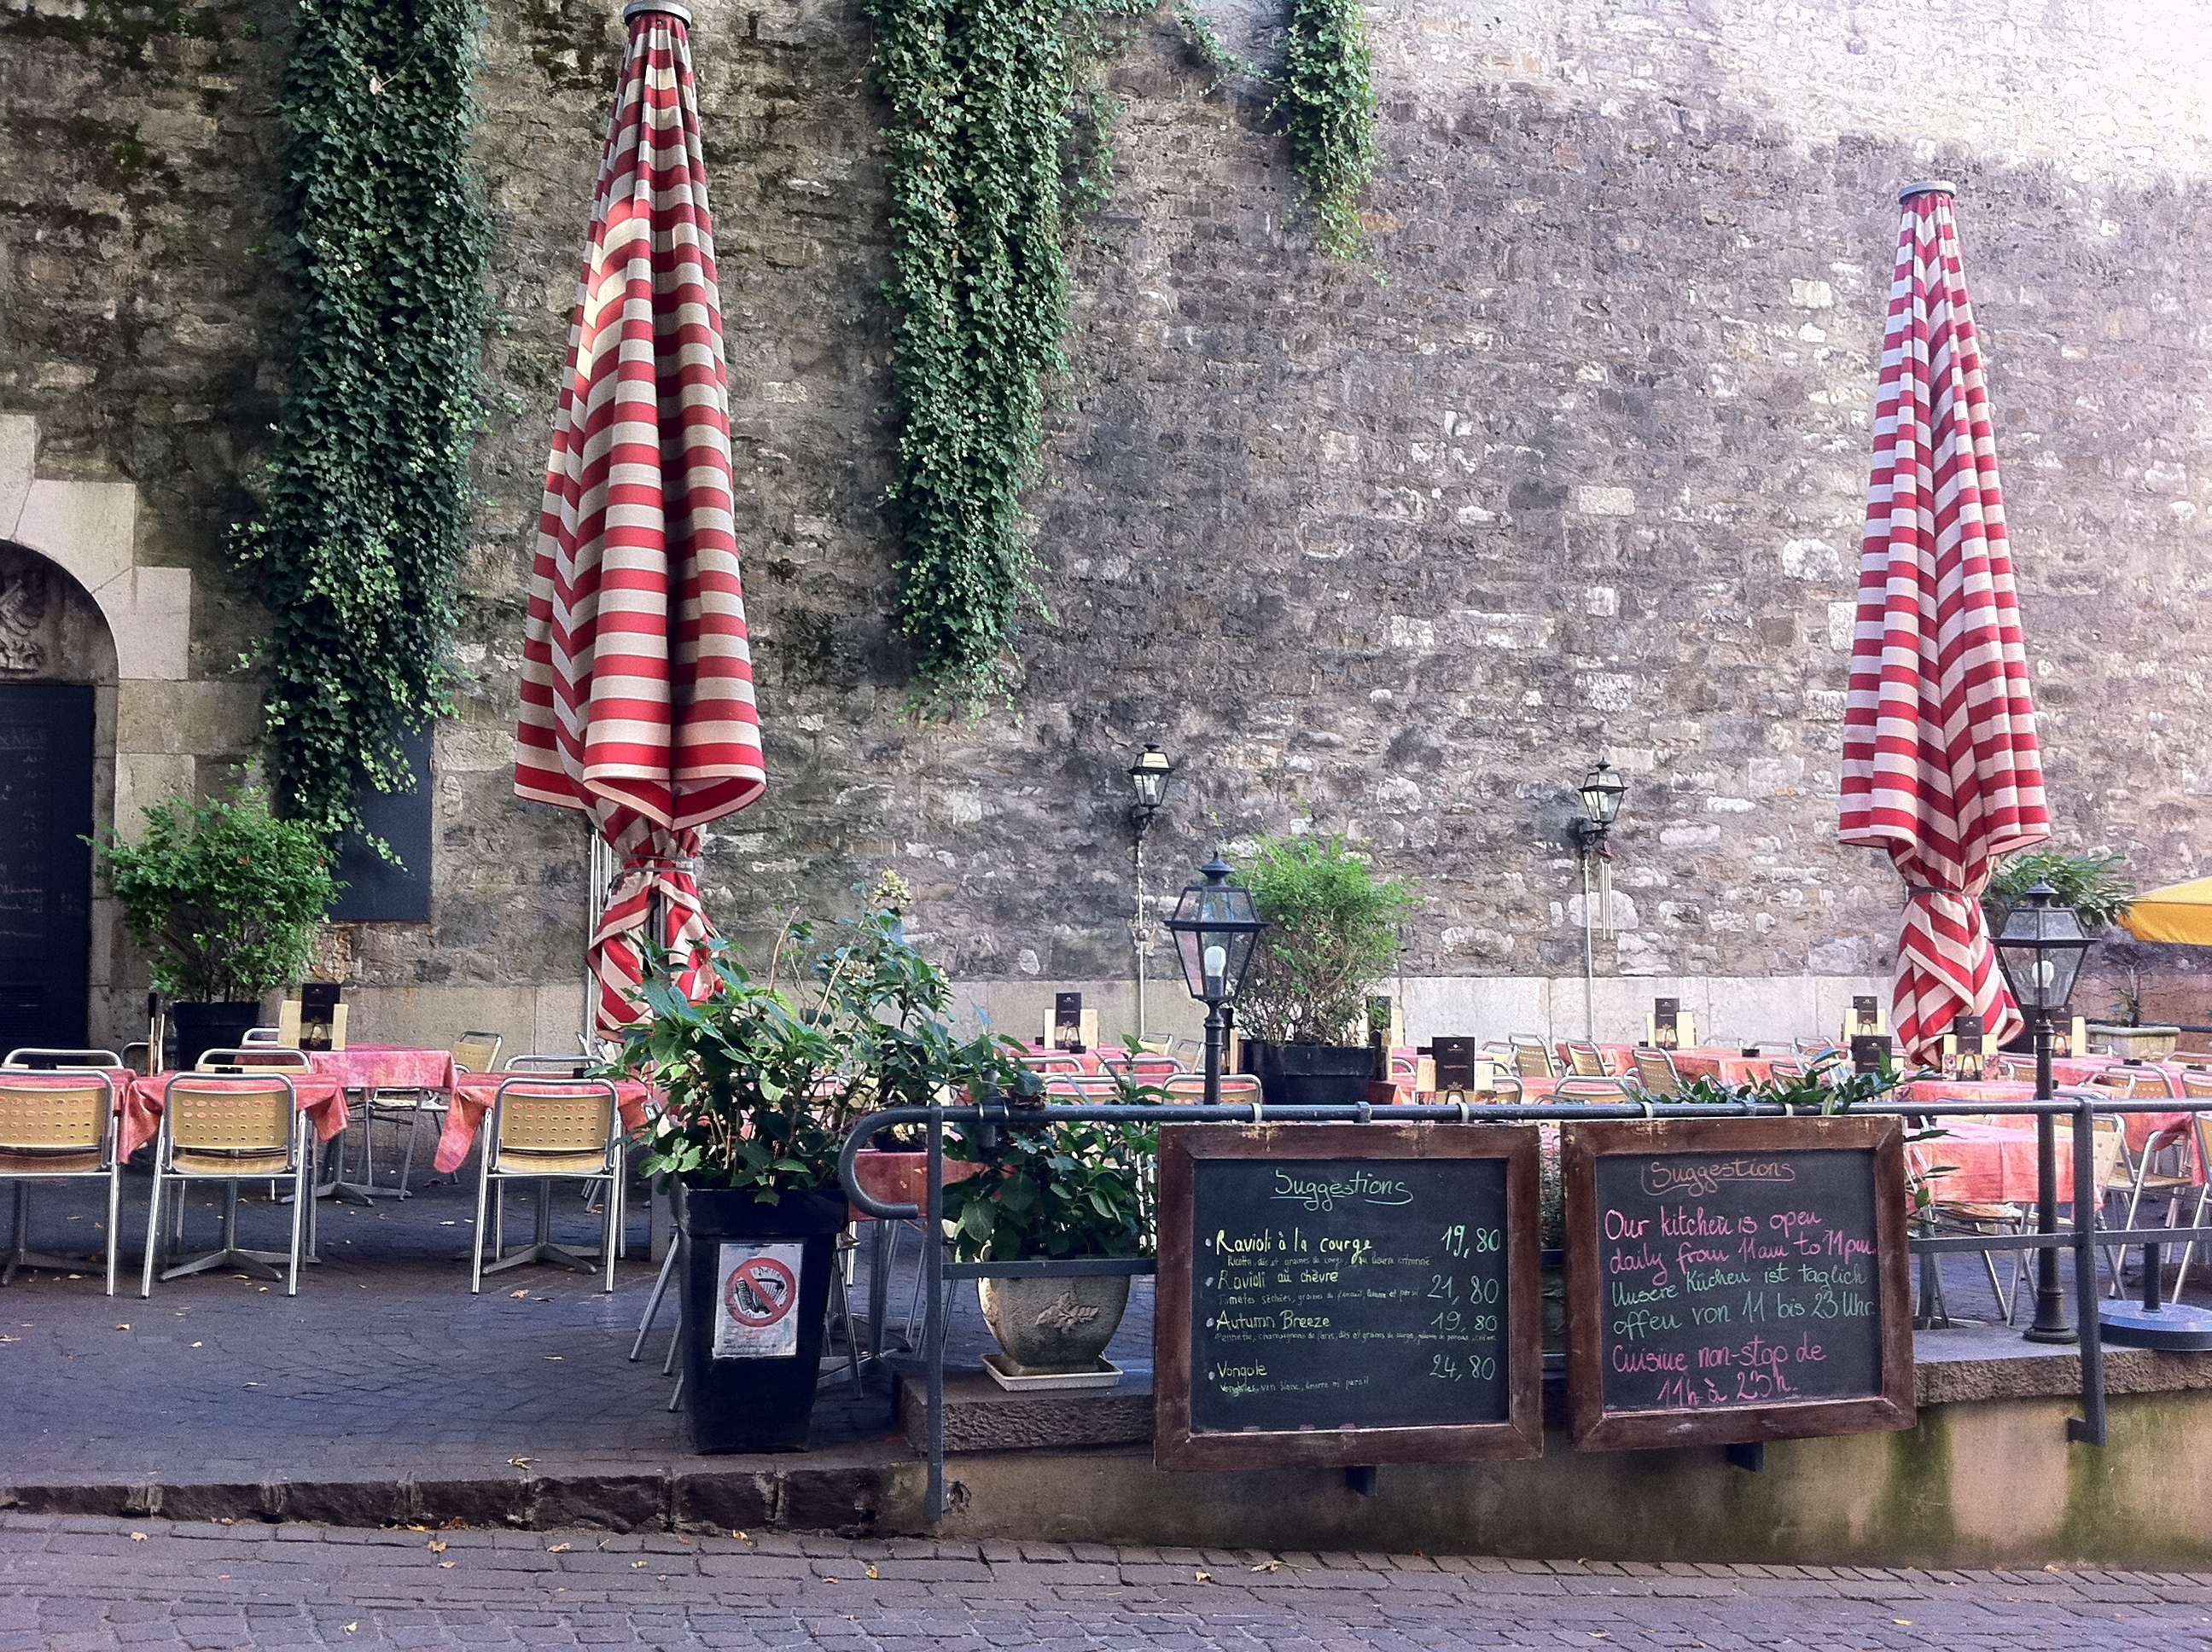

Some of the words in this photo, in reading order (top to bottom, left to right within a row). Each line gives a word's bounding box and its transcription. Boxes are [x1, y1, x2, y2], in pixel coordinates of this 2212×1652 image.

[1274, 1169, 1413, 1212] Suggestions
[1639, 1158, 1796, 1196] Suggestions
[1604, 1209, 1650, 1240] Our
[1660, 1205, 1733, 1236] kitchen
[1738, 1210, 1758, 1235] is
[1769, 1211, 1822, 1238] open
[1216, 1228, 1272, 1255] Ravioli
[1278, 1230, 1287, 1251] à
[1294, 1227, 1307, 1253] la
[1320, 1238, 1372, 1265] courge
[1440, 1224, 1501, 1259] 19,80
[1610, 1242, 1668, 1286] daily
[1676, 1242, 1729, 1275] from
[1793, 1231, 1820, 1255] to
[1218, 1270, 1266, 1289] Ravioli
[1278, 1271, 1292, 1283] au
[1301, 1269, 1339, 1283] chèvre
[1427, 1274, 1499, 1306] 21,80
[1612, 1282, 1679, 1307] Unsere
[1686, 1269, 1750, 1293] Küchen
[1765, 1262, 1790, 1283] ist
[1216, 1310, 1275, 1330] Autumn
[1279, 1309, 1331, 1330] Breeze
[1430, 1311, 1499, 1333] 19,80
[1613, 1310, 1682, 1341] offen
[1691, 1306, 1731, 1325] von
[1742, 1290, 1765, 1323] 11
[1778, 1292, 1806, 1318] bis
[1811, 1290, 1838, 1318] 23
[1217, 1358, 1267, 1383] Vongole
[1429, 1354, 1496, 1382] 24,80
[1613, 1345, 1688, 1372] Cuisine
[1698, 1335, 1789, 1369] non-stop
[1796, 1331, 1826, 1363] de
[1705, 1378, 1727, 1403] à
